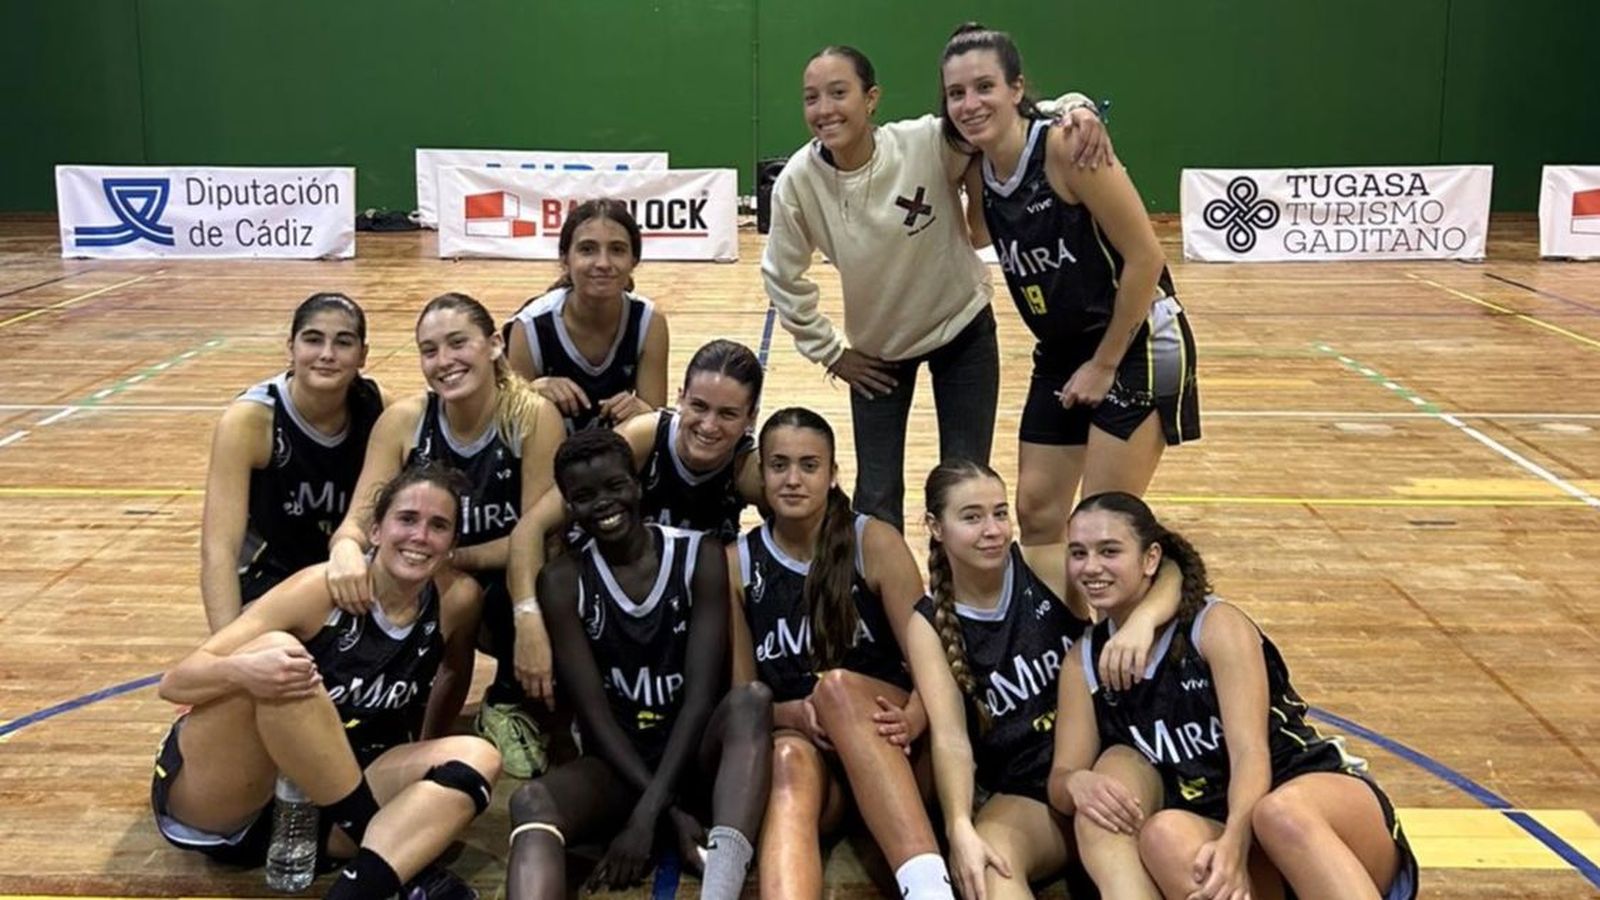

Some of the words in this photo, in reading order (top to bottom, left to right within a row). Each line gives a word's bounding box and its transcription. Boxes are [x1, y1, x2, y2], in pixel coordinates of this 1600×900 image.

[185, 176, 339, 210] Diputación
[1286, 173, 1430, 198] TUGASA
[1286, 200, 1444, 226] TURISMO
[188, 219, 223, 247] de
[235, 218, 313, 247] Cádiz
[1283, 227, 1466, 254] GADITANO
[1020, 285, 1048, 315] 19
